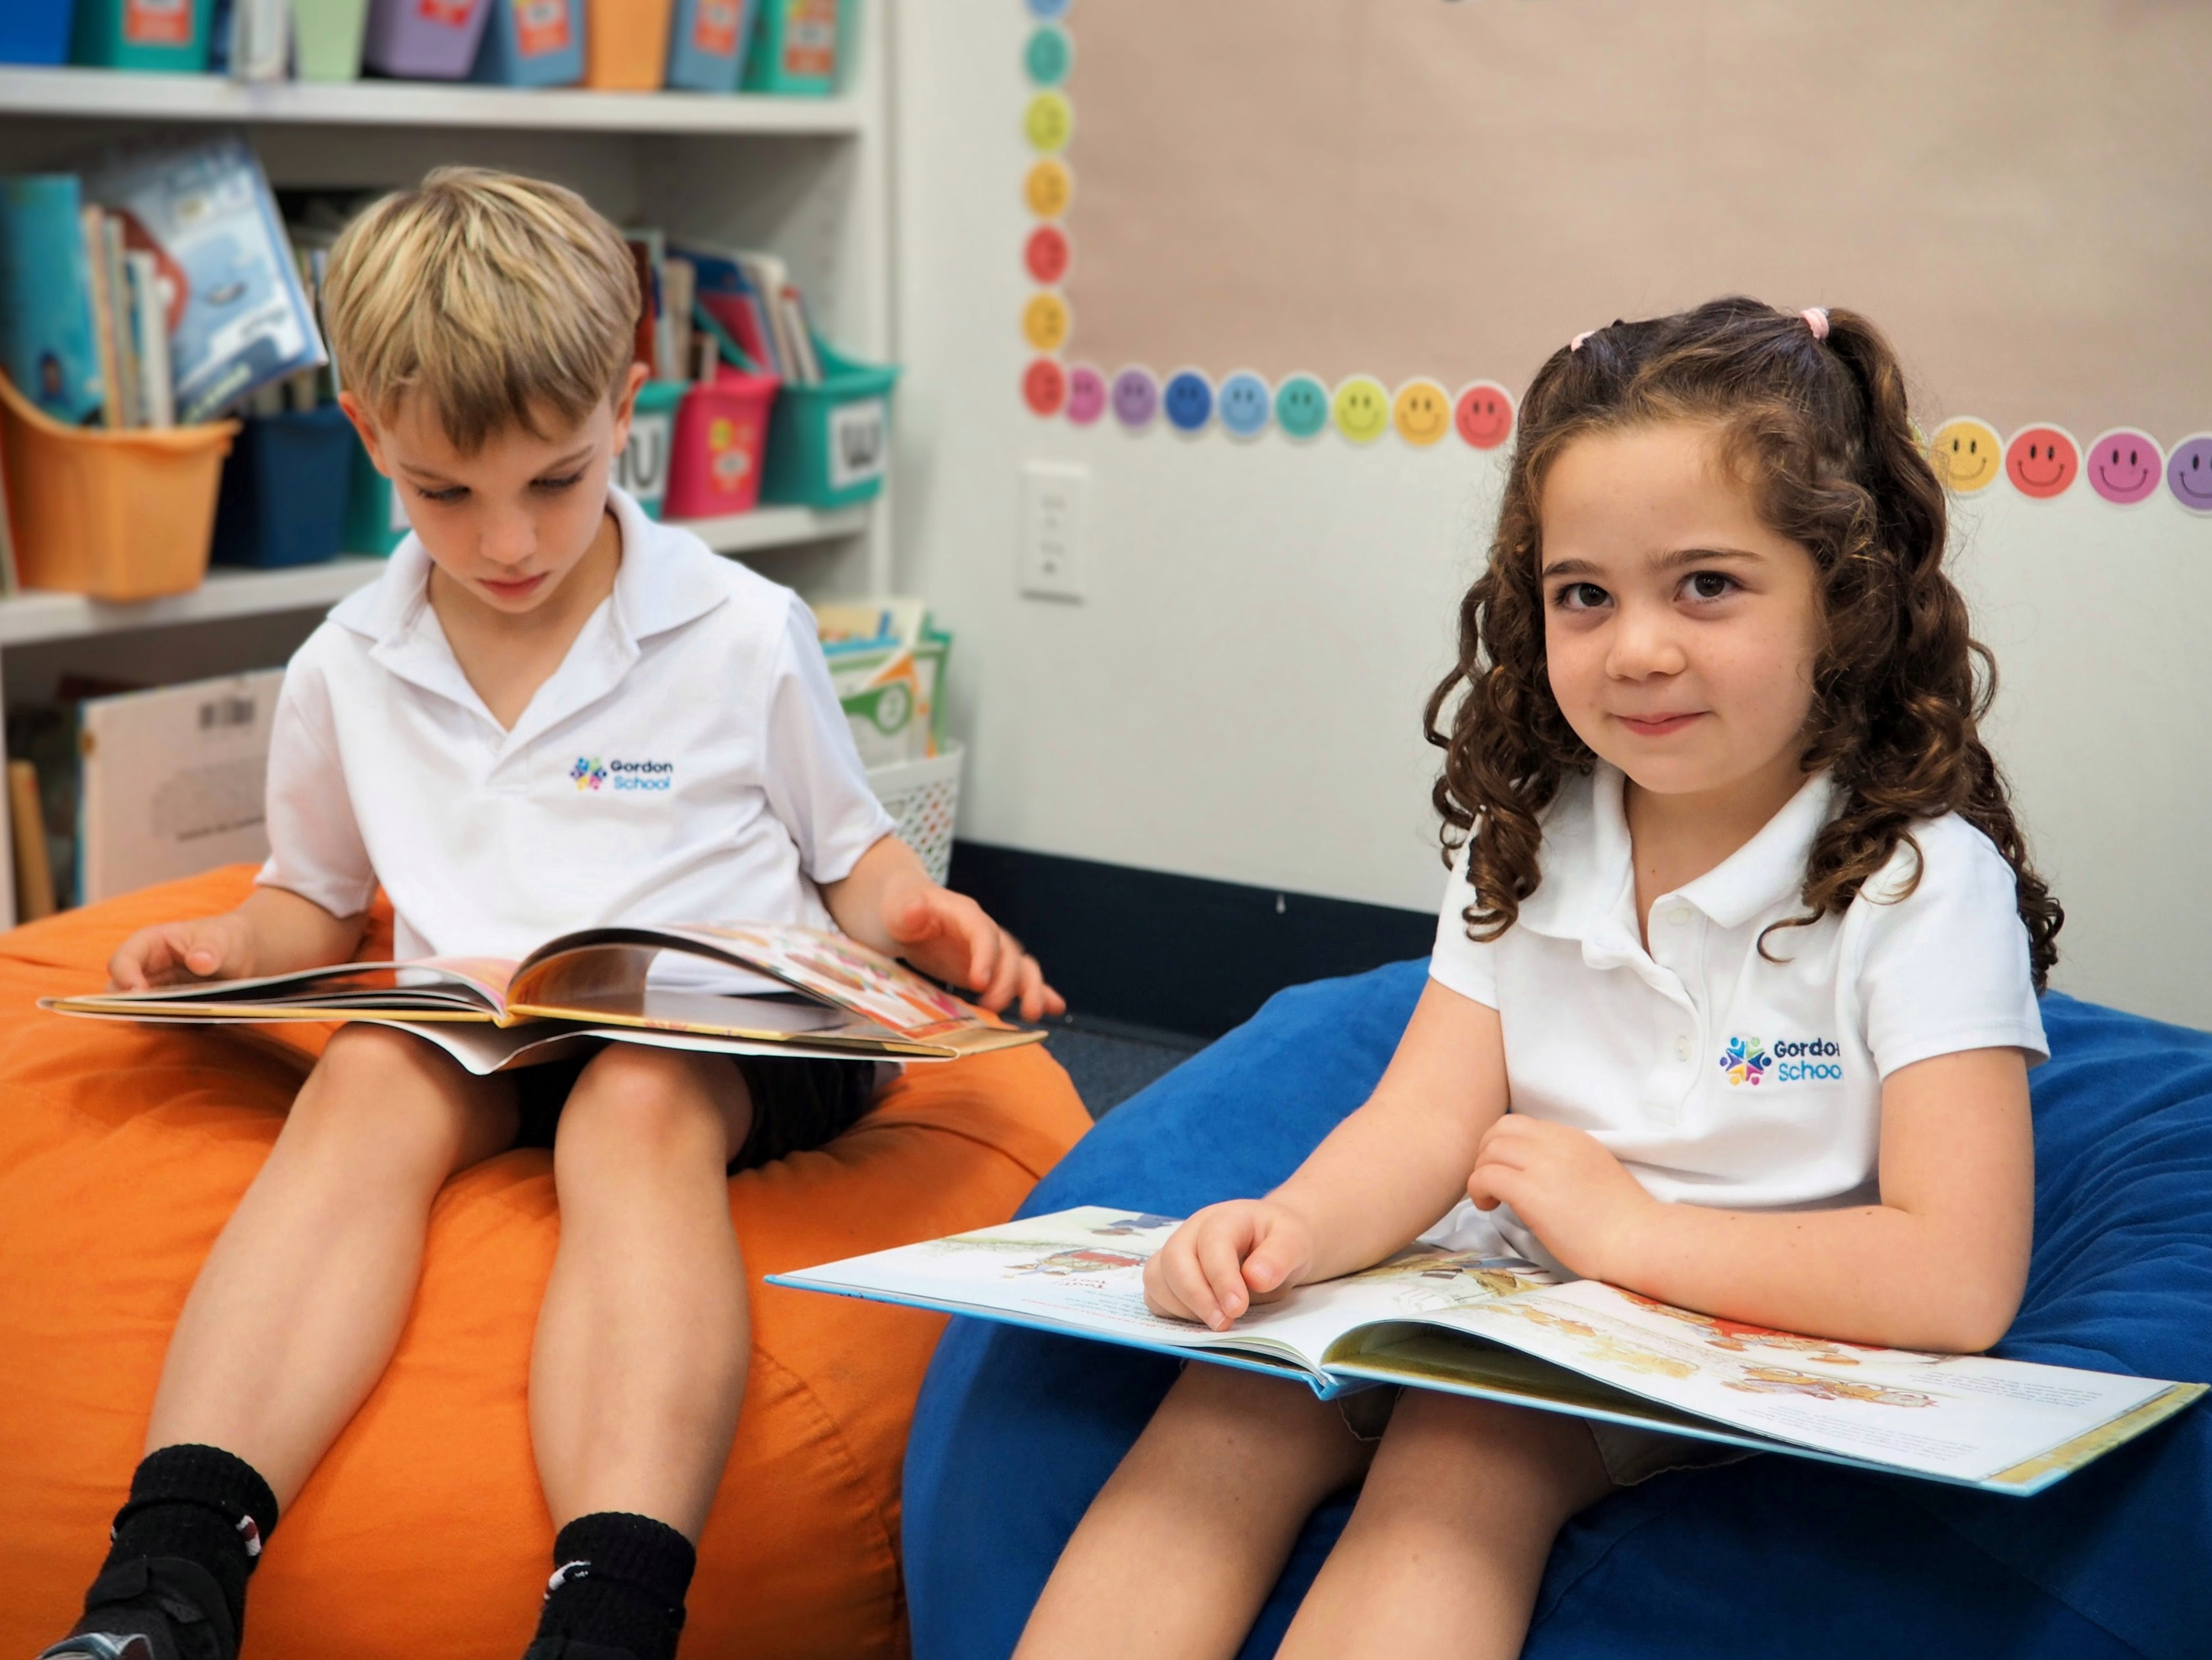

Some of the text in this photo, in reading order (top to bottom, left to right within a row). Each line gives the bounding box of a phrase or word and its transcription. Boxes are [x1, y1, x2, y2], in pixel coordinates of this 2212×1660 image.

[610, 760, 673, 773] Gordon
[614, 775, 671, 790] School
[1778, 1060, 1842, 1081] Schoo
